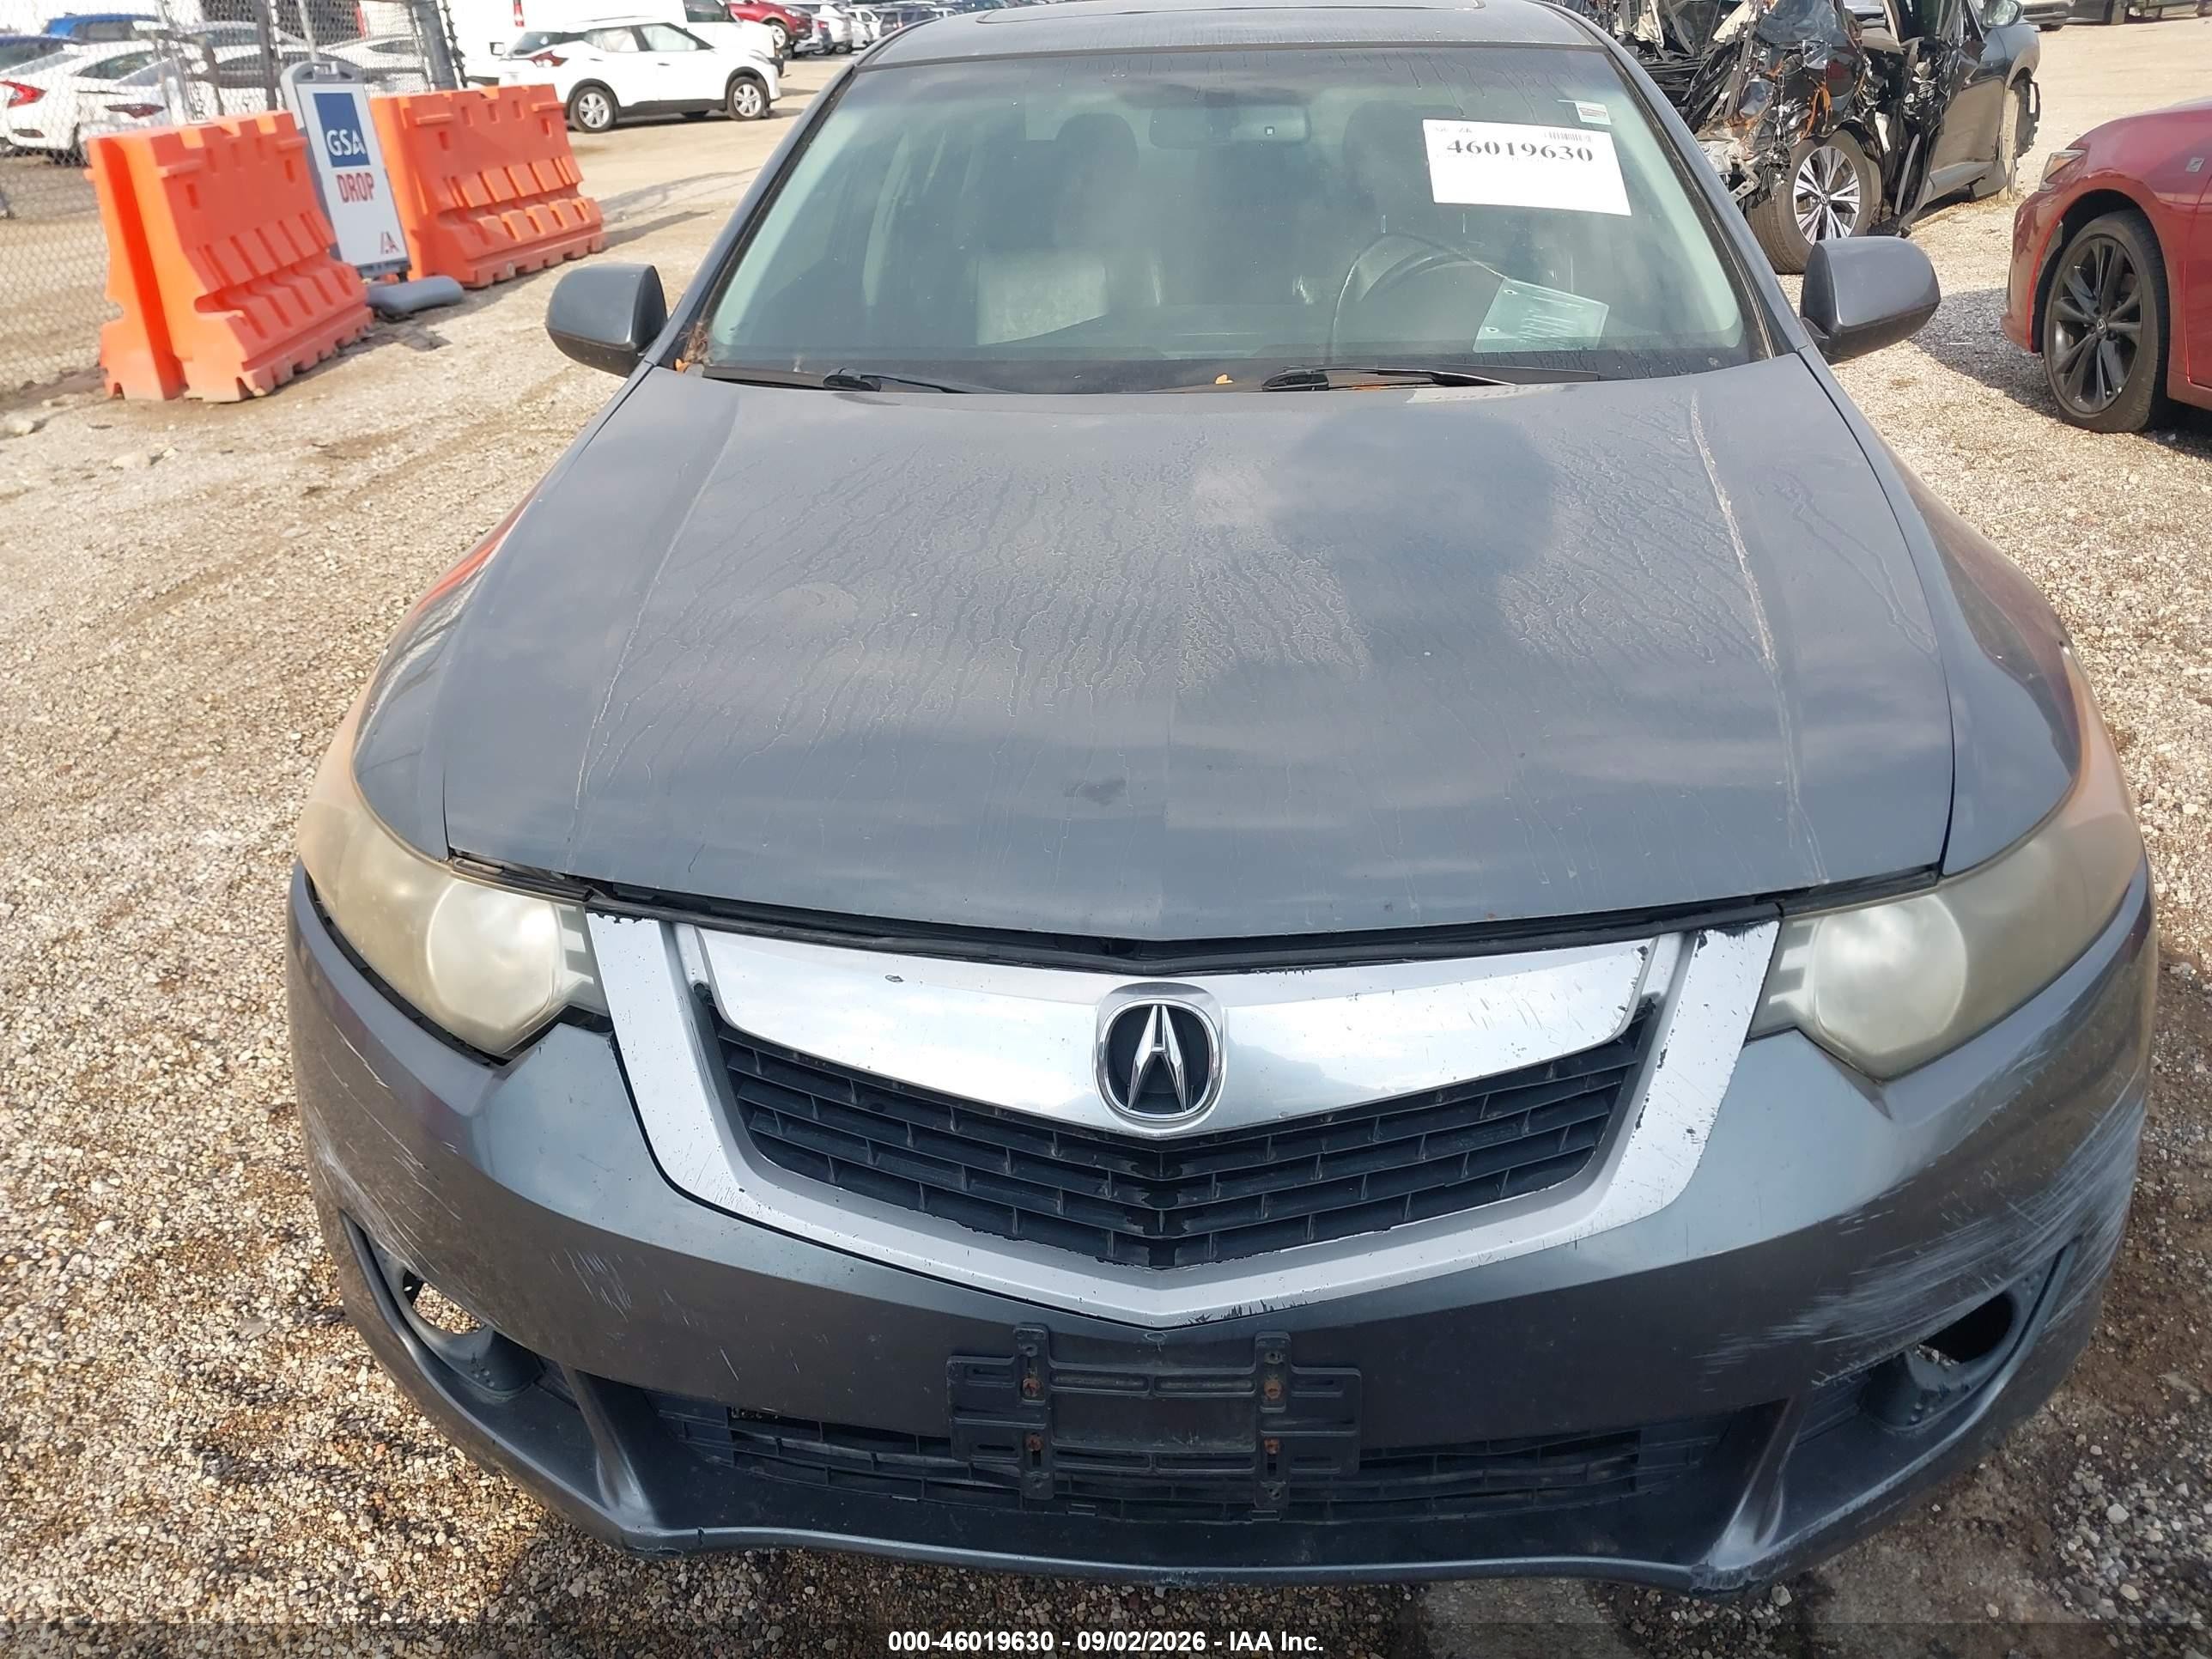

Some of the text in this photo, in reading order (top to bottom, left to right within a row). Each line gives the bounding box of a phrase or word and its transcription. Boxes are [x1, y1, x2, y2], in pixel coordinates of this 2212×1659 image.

[326, 129, 366, 156] GSA
[1446, 139, 1594, 161] 46019630
[336, 172, 374, 204] DROP
